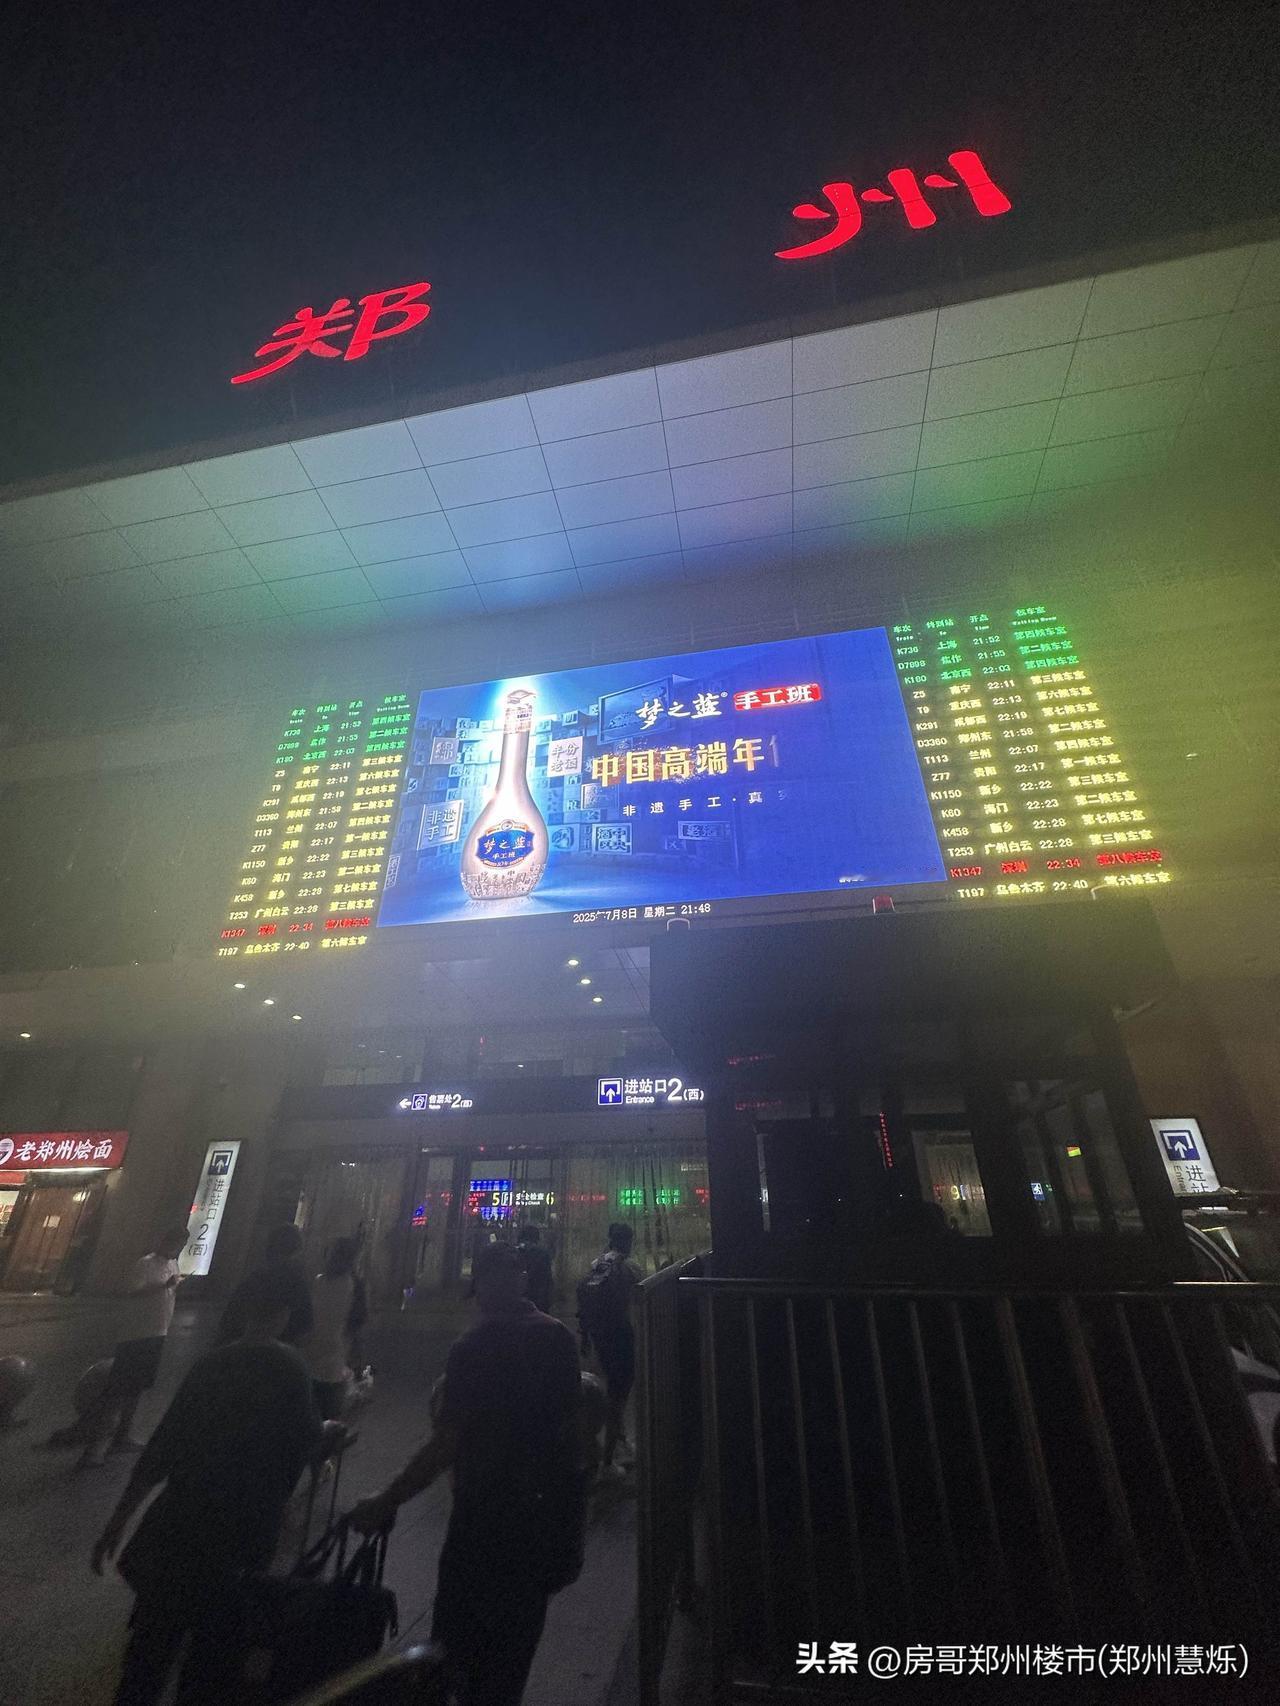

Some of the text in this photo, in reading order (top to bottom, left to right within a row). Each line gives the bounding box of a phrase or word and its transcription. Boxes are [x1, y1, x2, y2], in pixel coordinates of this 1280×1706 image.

[897, 626, 1067, 655] K730 上海 21:52 第四候车室
[941, 654, 962, 665] 焦作
[977, 650, 1006, 660] 21:55
[1019, 640, 1073, 655] 第二候车室
[904, 655, 1079, 684] K180 北京西 22:03 第四候车室
[735, 684, 813, 711] 手工班
[913, 670, 1086, 699] Z5 南宁 22:11 第三候车室
[917, 686, 1093, 715] T9 重庆西 22:13 第六候车室
[915, 702, 1100, 731] K291 成都西 22:19 第七候车室
[917, 718, 1107, 748] D3360 郑州东 21:58 第二候车室
[924, 735, 1114, 764] T113 兰州 22:07 第四候车室
[931, 753, 1121, 781] Z77 贵阳 22:17 第一候车室
[931, 771, 1130, 800] K1150 新乡 22:22 第三候车室
[941, 809, 961, 818] K60
[1026, 799, 1059, 810] 22:23
[1074, 790, 1138, 806] 第二候车室
[942, 809, 1146, 837] K458 新乡 22:28 第七候车室
[948, 829, 1154, 857] T253 广州白云 22:28 第三候车室
[950, 850, 1163, 878] K1347 深圳 22:34 第八候车室
[957, 871, 1171, 898] T197 乌鲁木齐 22:40 第六候车室
[644, 906, 676, 918] 星期二
[681, 903, 711, 915] 21:48
[625, 1095, 655, 1104] Entrance
[14, 1139, 113, 1162] 老郑州烩面
